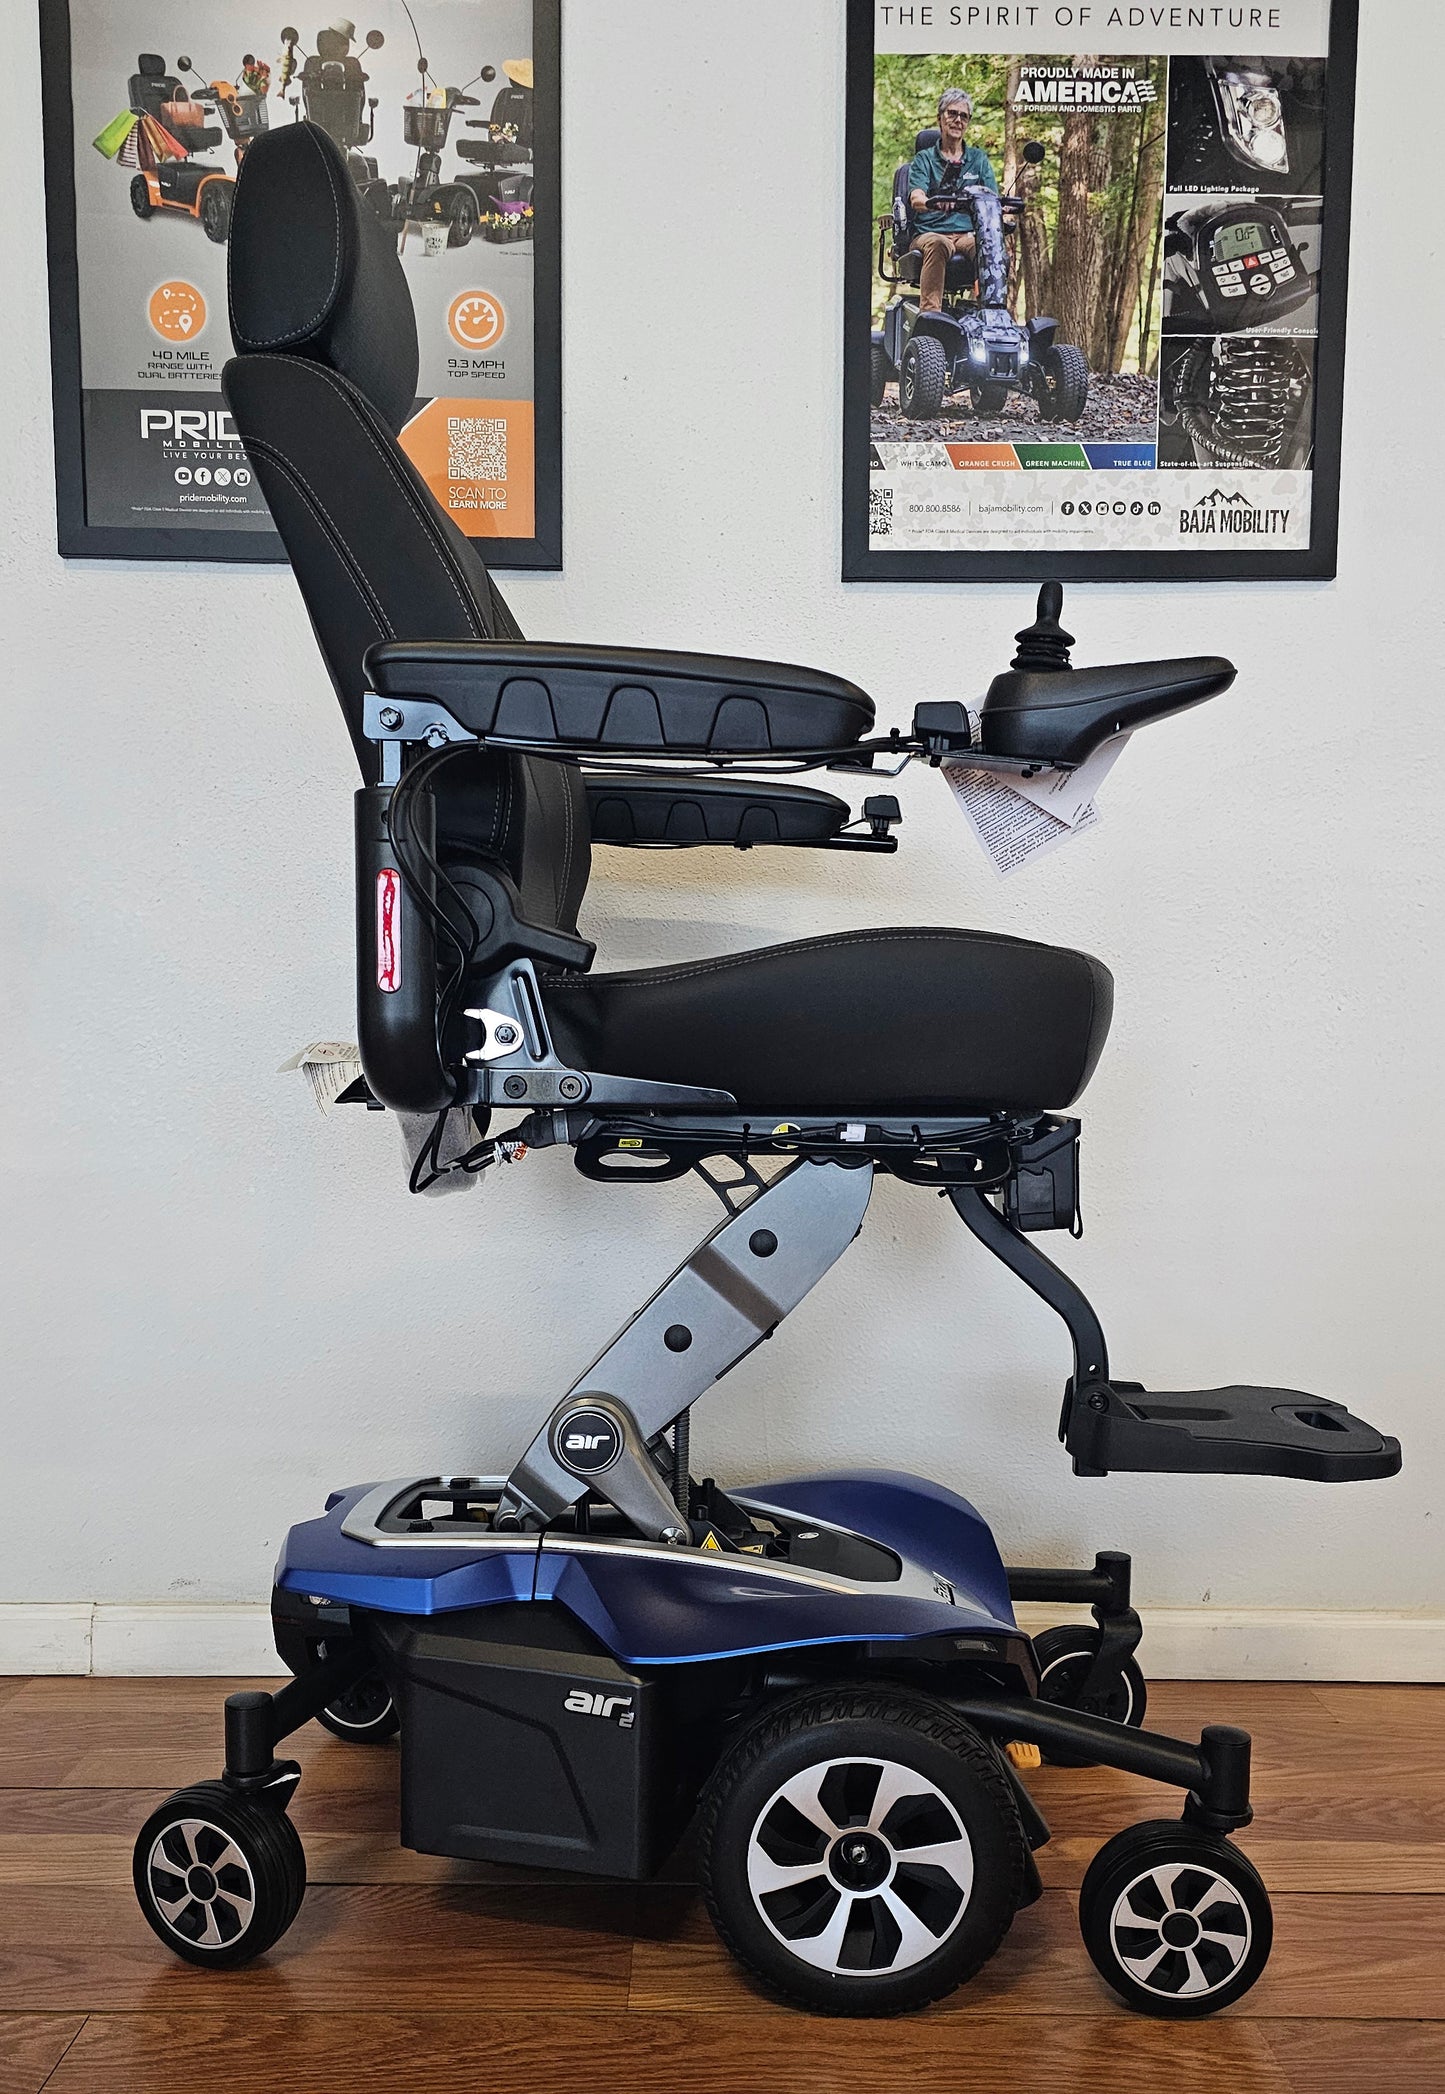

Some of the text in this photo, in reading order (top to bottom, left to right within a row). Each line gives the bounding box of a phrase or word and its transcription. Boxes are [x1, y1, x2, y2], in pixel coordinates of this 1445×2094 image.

[880, 6, 1281, 28] THE SPIRIT OF ADVENTURE
[1020, 67, 1135, 79] PROUDLY MADE IN
[1014, 80, 1140, 103] AMERICA
[1058, 105, 1076, 113] AND
[1077, 105, 1117, 113] DOMESTIC
[1200, 185, 1229, 193] Lighting
[1231, 185, 1260, 194] Package
[152, 350, 210, 361] 40 MILE
[147, 362, 184, 370] RANGE
[447, 359, 505, 369] 9.3 MPH
[137, 371, 166, 379] DUAL
[447, 370, 506, 379] TOP SPEED
[163, 451, 188, 459] LIVE
[179, 493, 247, 504] pridemobility.com
[448, 486, 507, 500] SCAN TO
[449, 500, 507, 510] LEARN MORE
[909, 504, 961, 513] 800.800.8586
[978, 504, 1044, 515] bajamobility.com
[1180, 509, 1290, 533] BAJA MOBILITY
[565, 1433, 610, 1450] air
[564, 1690, 633, 1717] air
